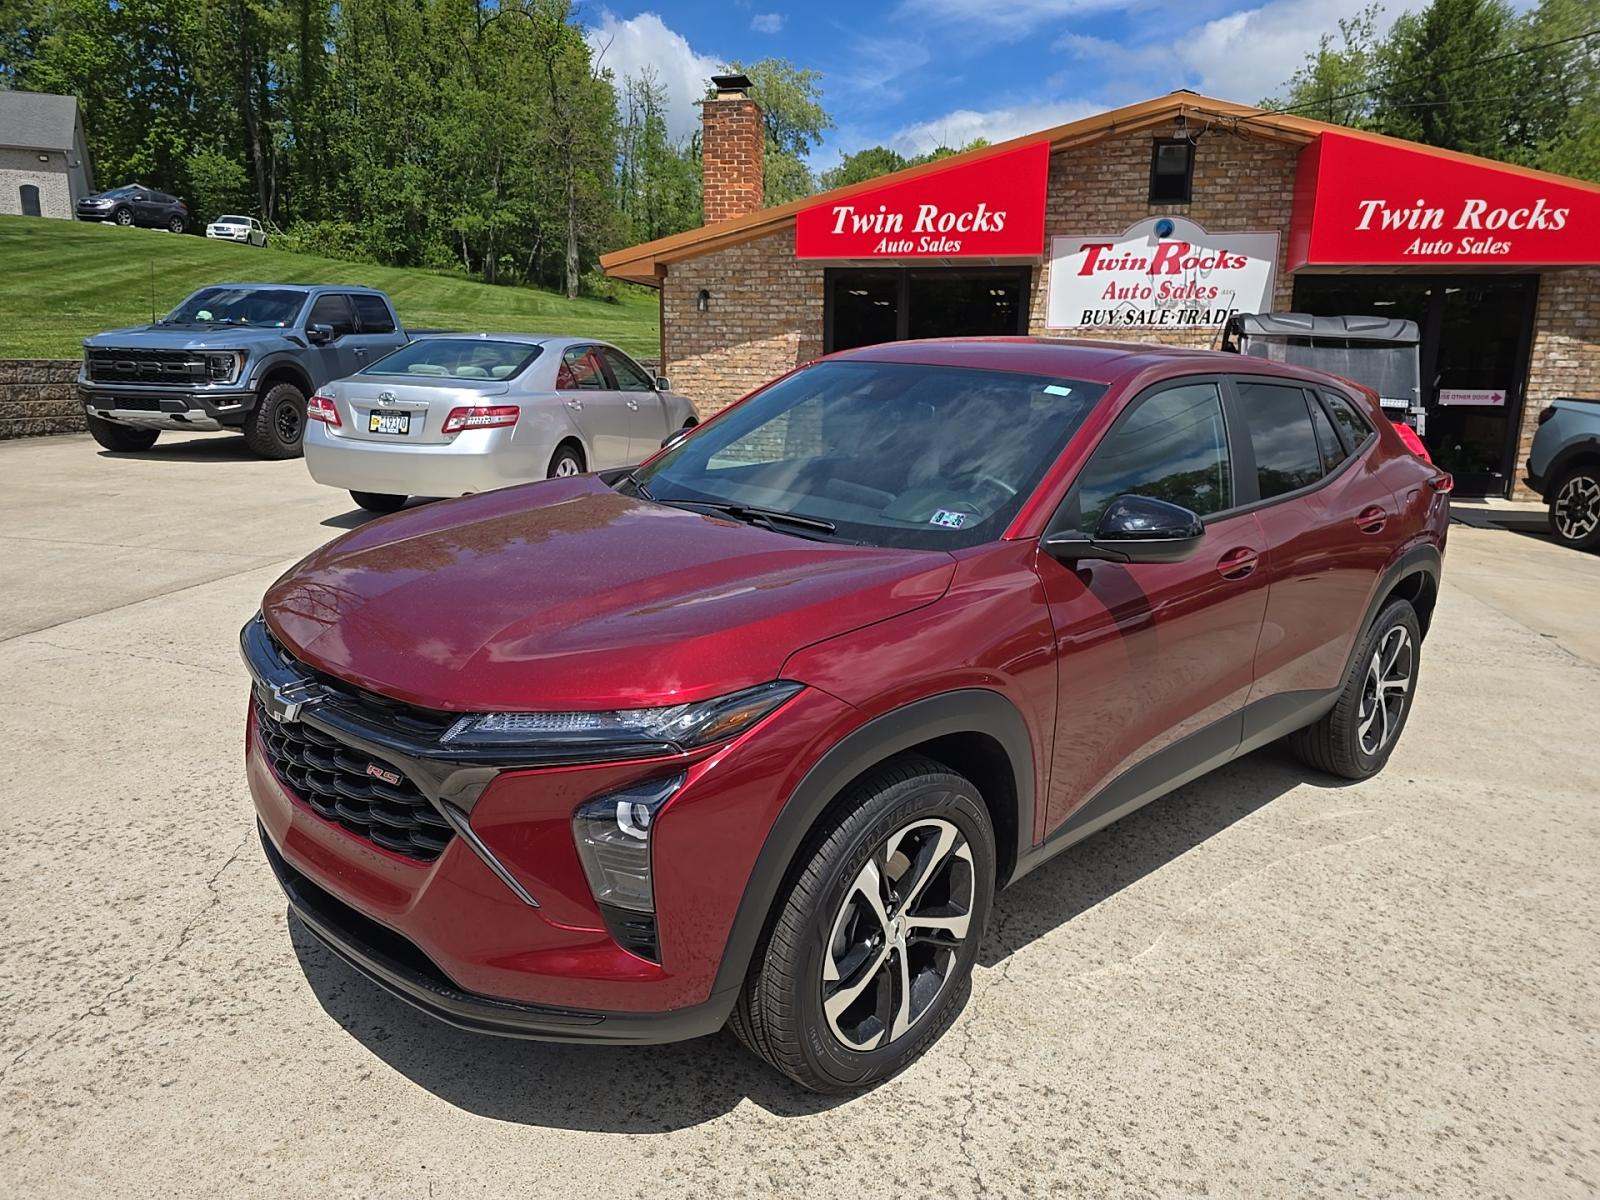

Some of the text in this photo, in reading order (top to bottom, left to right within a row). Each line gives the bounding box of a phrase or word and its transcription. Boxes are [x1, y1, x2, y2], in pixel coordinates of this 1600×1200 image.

[831, 201, 1007, 235] Twin Rocks
[1355, 198, 1570, 231] Twin Rocks
[873, 236, 962, 254] Auto Sales
[1403, 236, 1512, 255] Auto Sales
[1077, 241, 1248, 276] Twin Rocks
[1101, 281, 1152, 300] Auto
[1157, 280, 1218, 300] Sales
[366, 762, 401, 785] RS
